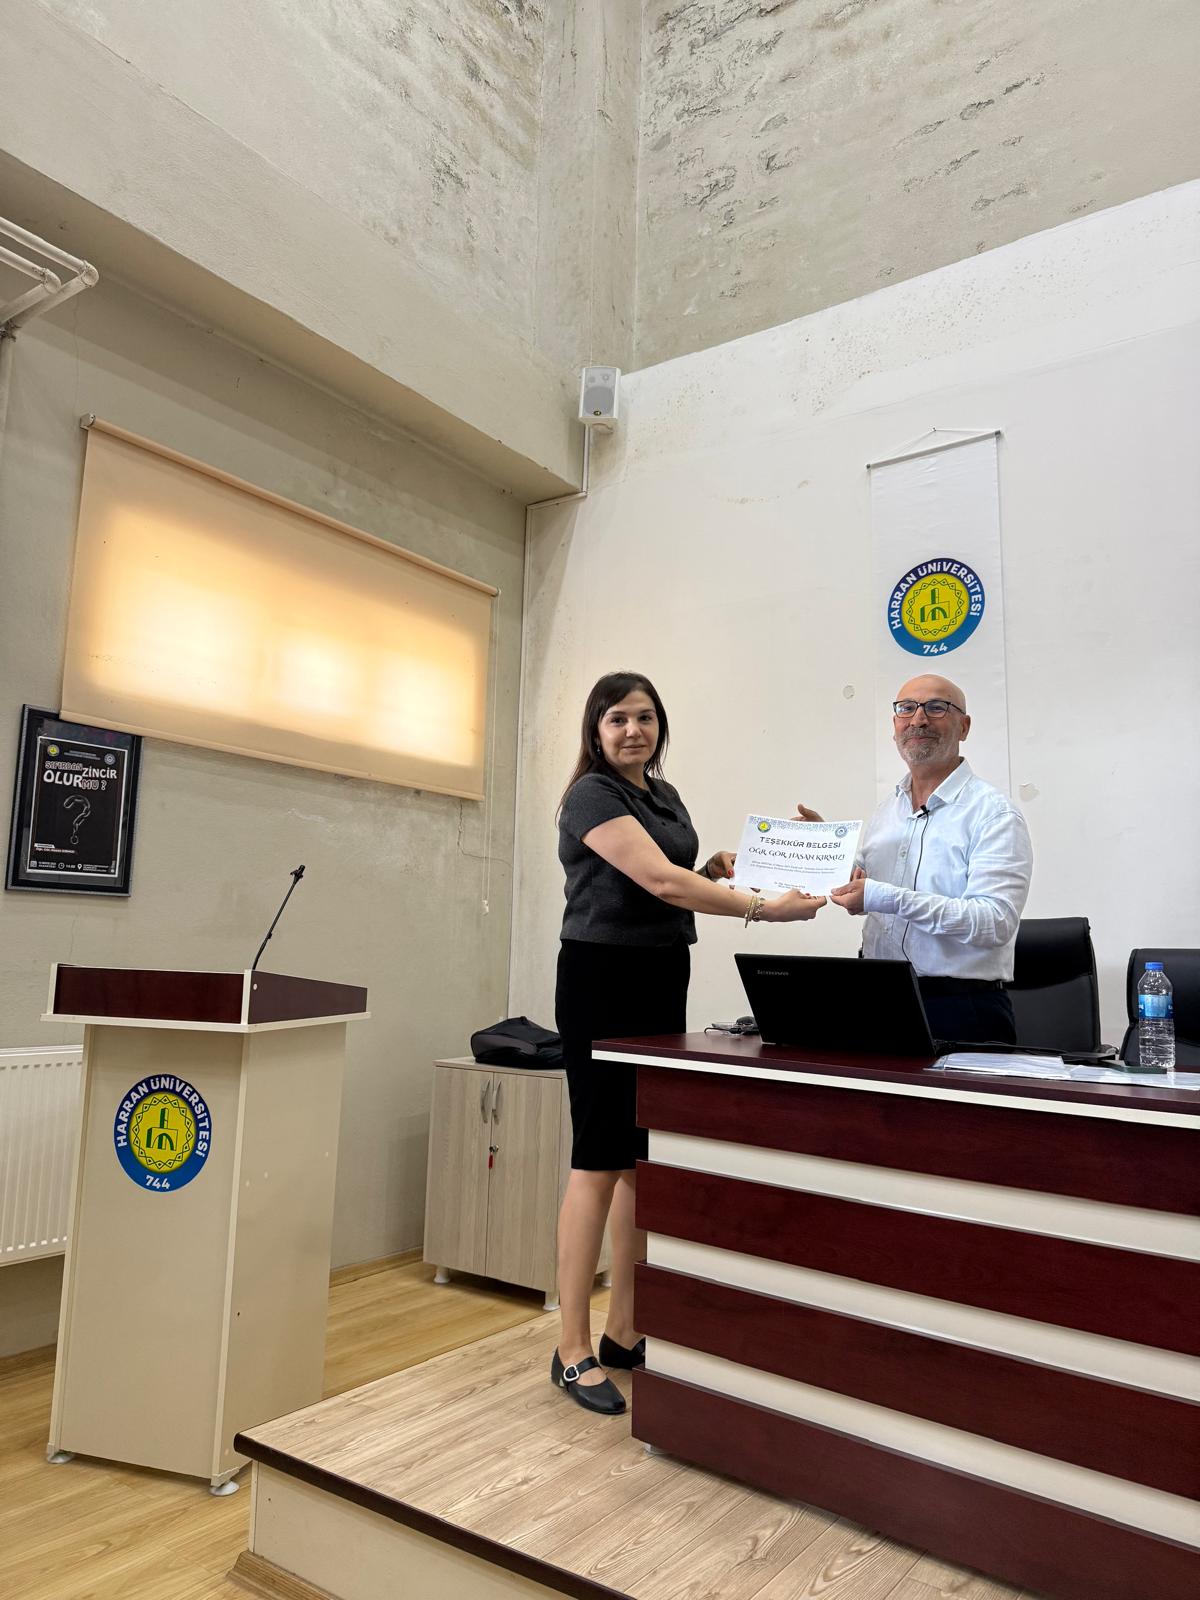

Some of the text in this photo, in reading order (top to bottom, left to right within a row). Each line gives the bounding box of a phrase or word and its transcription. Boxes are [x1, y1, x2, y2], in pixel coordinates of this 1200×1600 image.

[890, 561, 982, 630] HARRAN ÜNİVERSİTESİ
[922, 643, 948, 654] 744
[43, 770, 83, 788] OLUR
[82, 779, 99, 790] MU
[82, 766, 117, 779] ZİNCİR
[759, 836, 805, 848] TEŞEKKÜR
[116, 1076, 210, 1158] HARRAN ÜNİVERSİTESİ
[145, 1174, 170, 1190] 744
